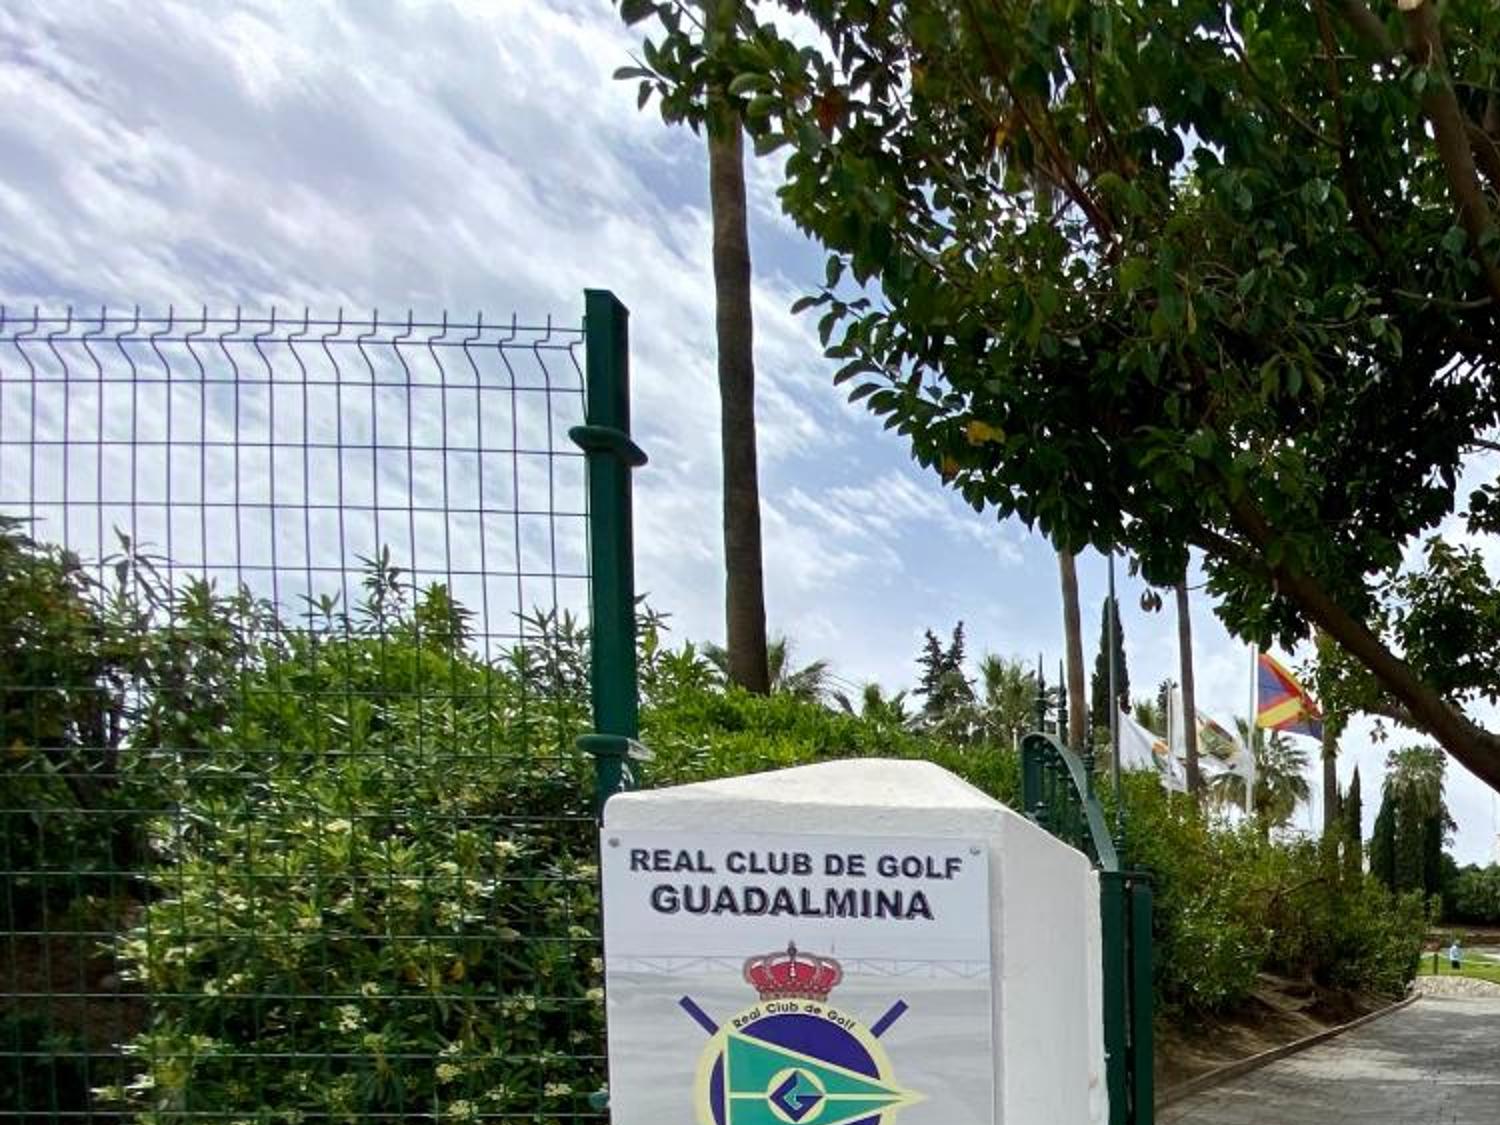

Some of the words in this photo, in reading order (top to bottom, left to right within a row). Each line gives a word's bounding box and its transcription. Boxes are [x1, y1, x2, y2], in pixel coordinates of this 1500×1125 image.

[630, 849, 715, 873] REAL
[726, 851, 813, 876] CLUB
[824, 853, 866, 877] DE
[877, 855, 962, 880] GOLF
[651, 884, 935, 921] GUADALMINA
[732, 1006, 761, 1028] Real
[765, 1002, 799, 1013] Club
[803, 1004, 822, 1014] de
[827, 1009, 856, 1030] Golf
